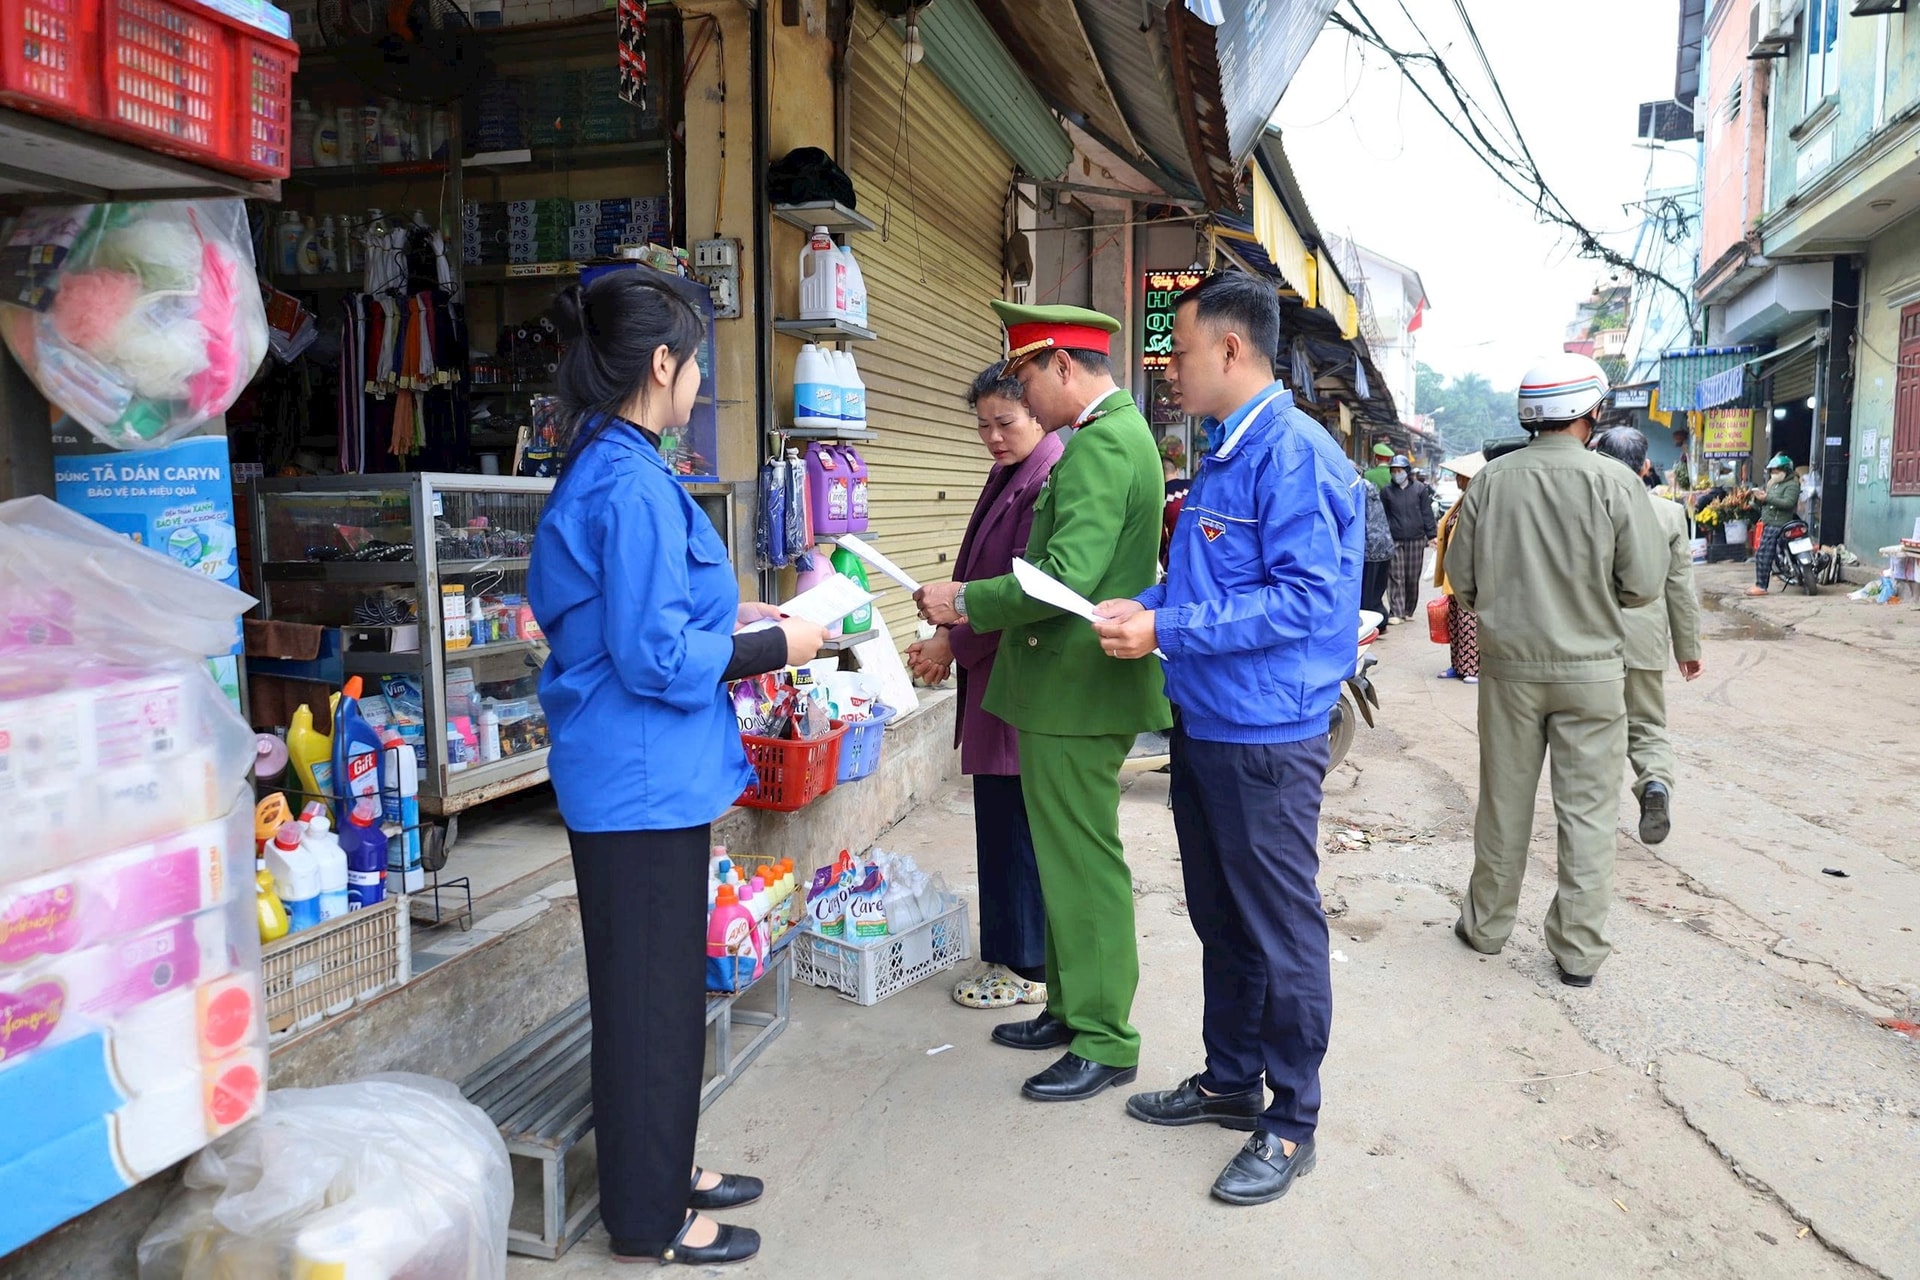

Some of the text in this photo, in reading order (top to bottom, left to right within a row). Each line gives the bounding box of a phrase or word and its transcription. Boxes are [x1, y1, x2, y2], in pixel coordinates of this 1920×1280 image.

[512, 202, 527, 212] PS
[579, 204, 590, 213] PS
[634, 200, 648, 210] PS
[515, 216, 529, 225] PS
[580, 218, 592, 227] PS
[635, 214, 649, 224] PS
[513, 230, 527, 239] PS
[573, 230, 585, 238] PS
[629, 226, 643, 235] PS
[515, 243, 529, 252] PS
[573, 243, 585, 252] PS
[92, 463, 117, 481] TÃ
[121, 464, 160, 481] DÁN
[164, 467, 220, 480] CARYN
[88, 485, 197, 499] BẢO VỆ DA HIỆU QUẢ
[387, 683, 406, 697] Vim
[354, 753, 374, 776] Gift
[850, 896, 883, 917] Care
